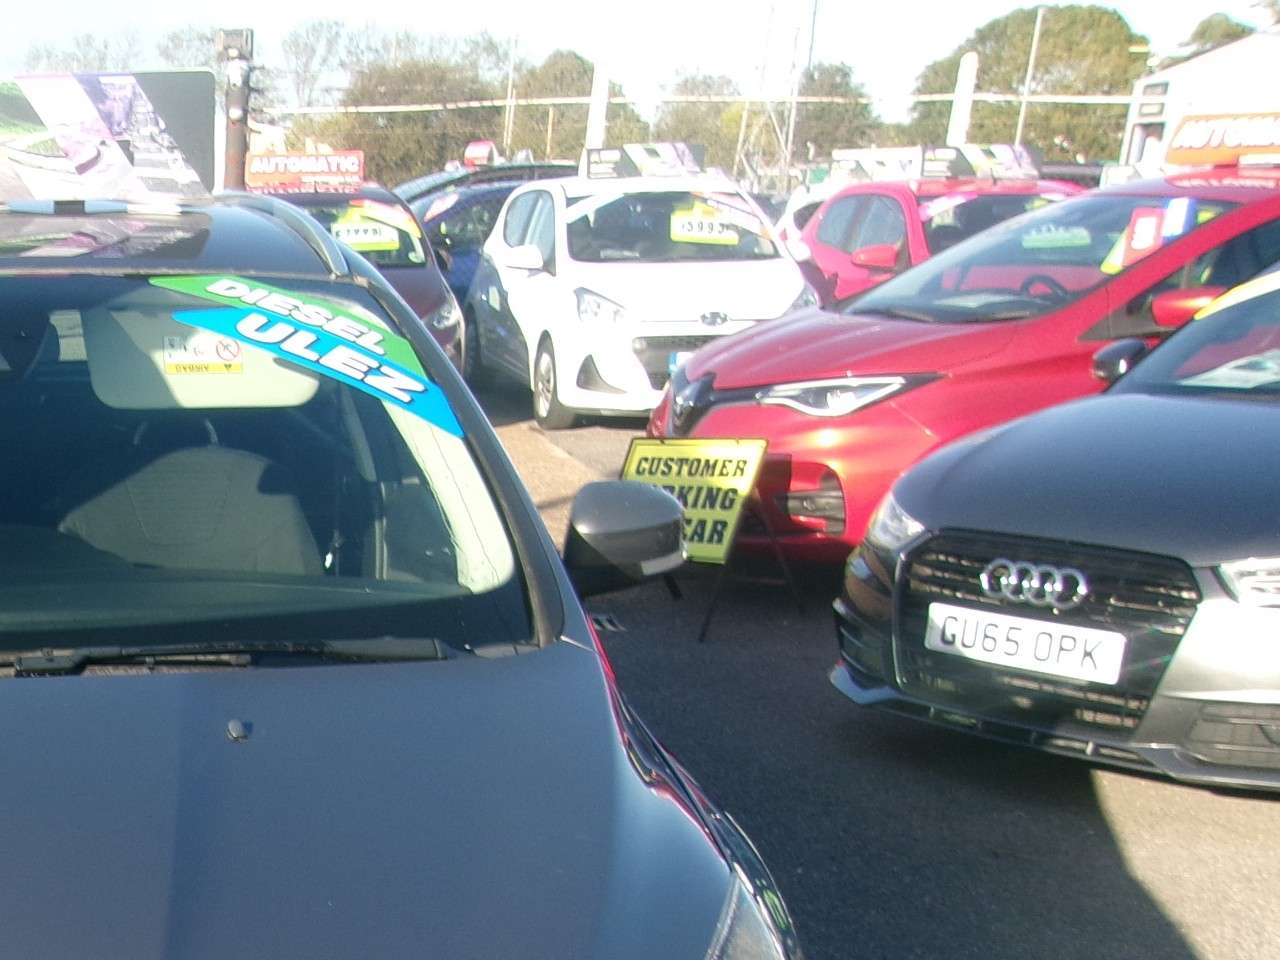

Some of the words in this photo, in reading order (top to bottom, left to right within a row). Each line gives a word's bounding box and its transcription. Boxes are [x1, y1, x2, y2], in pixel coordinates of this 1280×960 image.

[250, 156, 360, 174] AUTOMATIC
[206, 278, 387, 356] DIESEL
[236, 312, 427, 404] ULEZ
[635, 456, 748, 478] CUSTOMER
[940, 615, 1022, 657] GU65
[1033, 631, 1103, 671] OPK
